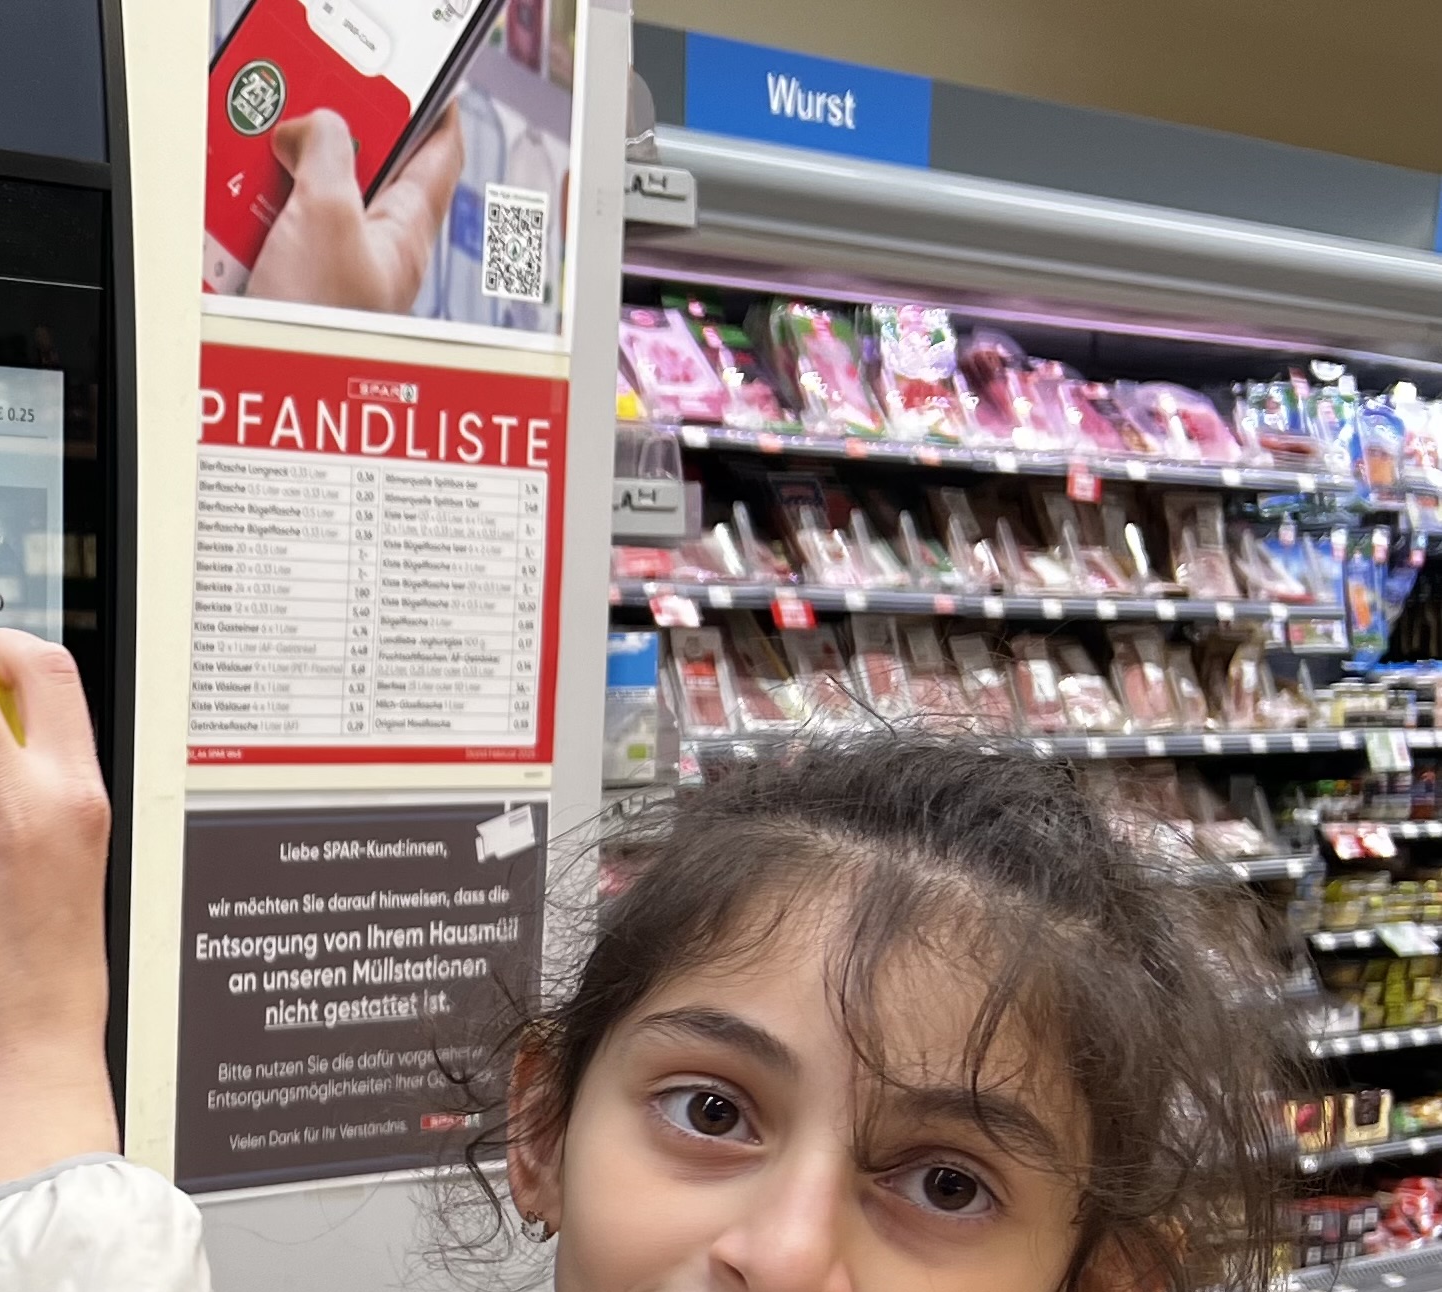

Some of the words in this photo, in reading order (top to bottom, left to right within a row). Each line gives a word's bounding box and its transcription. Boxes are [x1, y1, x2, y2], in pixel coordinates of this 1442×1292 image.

[767, 72, 856, 130] Wurst
[359, 382, 400, 398] SPAR
[7, 406, 36, 424] 0.25
[198, 388, 551, 468] PFANDLISTE
[279, 842, 319, 861] Liebe
[323, 839, 448, 861] SPAR-Kund:innen,
[208, 898, 230, 917] wir
[234, 896, 298, 917] möchten
[302, 894, 324, 911] Sie
[328, 890, 376, 910] darauf
[379, 888, 450, 909] hinweisen,
[454, 888, 485, 905] dass
[488, 884, 510, 903] die
[195, 929, 318, 962] Entsorgung
[323, 929, 360, 951] von
[367, 924, 423, 949] Ihrem
[429, 917, 519, 945] Hausmüll
[228, 971, 256, 993] an
[263, 963, 346, 991] unseren
[353, 955, 487, 985] Müllstationen
[265, 999, 318, 1025] nicht
[324, 992, 417, 1026] gestattet
[423, 989, 450, 1014] ist.
[218, 1062, 252, 1082] Bitte
[256, 1057, 303, 1078] nutzen
[307, 1054, 329, 1073] Sie
[332, 1052, 354, 1072] die
[357, 1046, 394, 1068] dafür
[207, 1073, 392, 1109] Entsorgungsmöglichkeiten
[395, 1073, 423, 1090] Ihrer
[229, 1130, 266, 1151] Vielen
[269, 1126, 300, 1147] Dank
[304, 1123, 320, 1143] für
[322, 1123, 336, 1140] Ihr
[339, 1117, 408, 1139] Verständnis.
